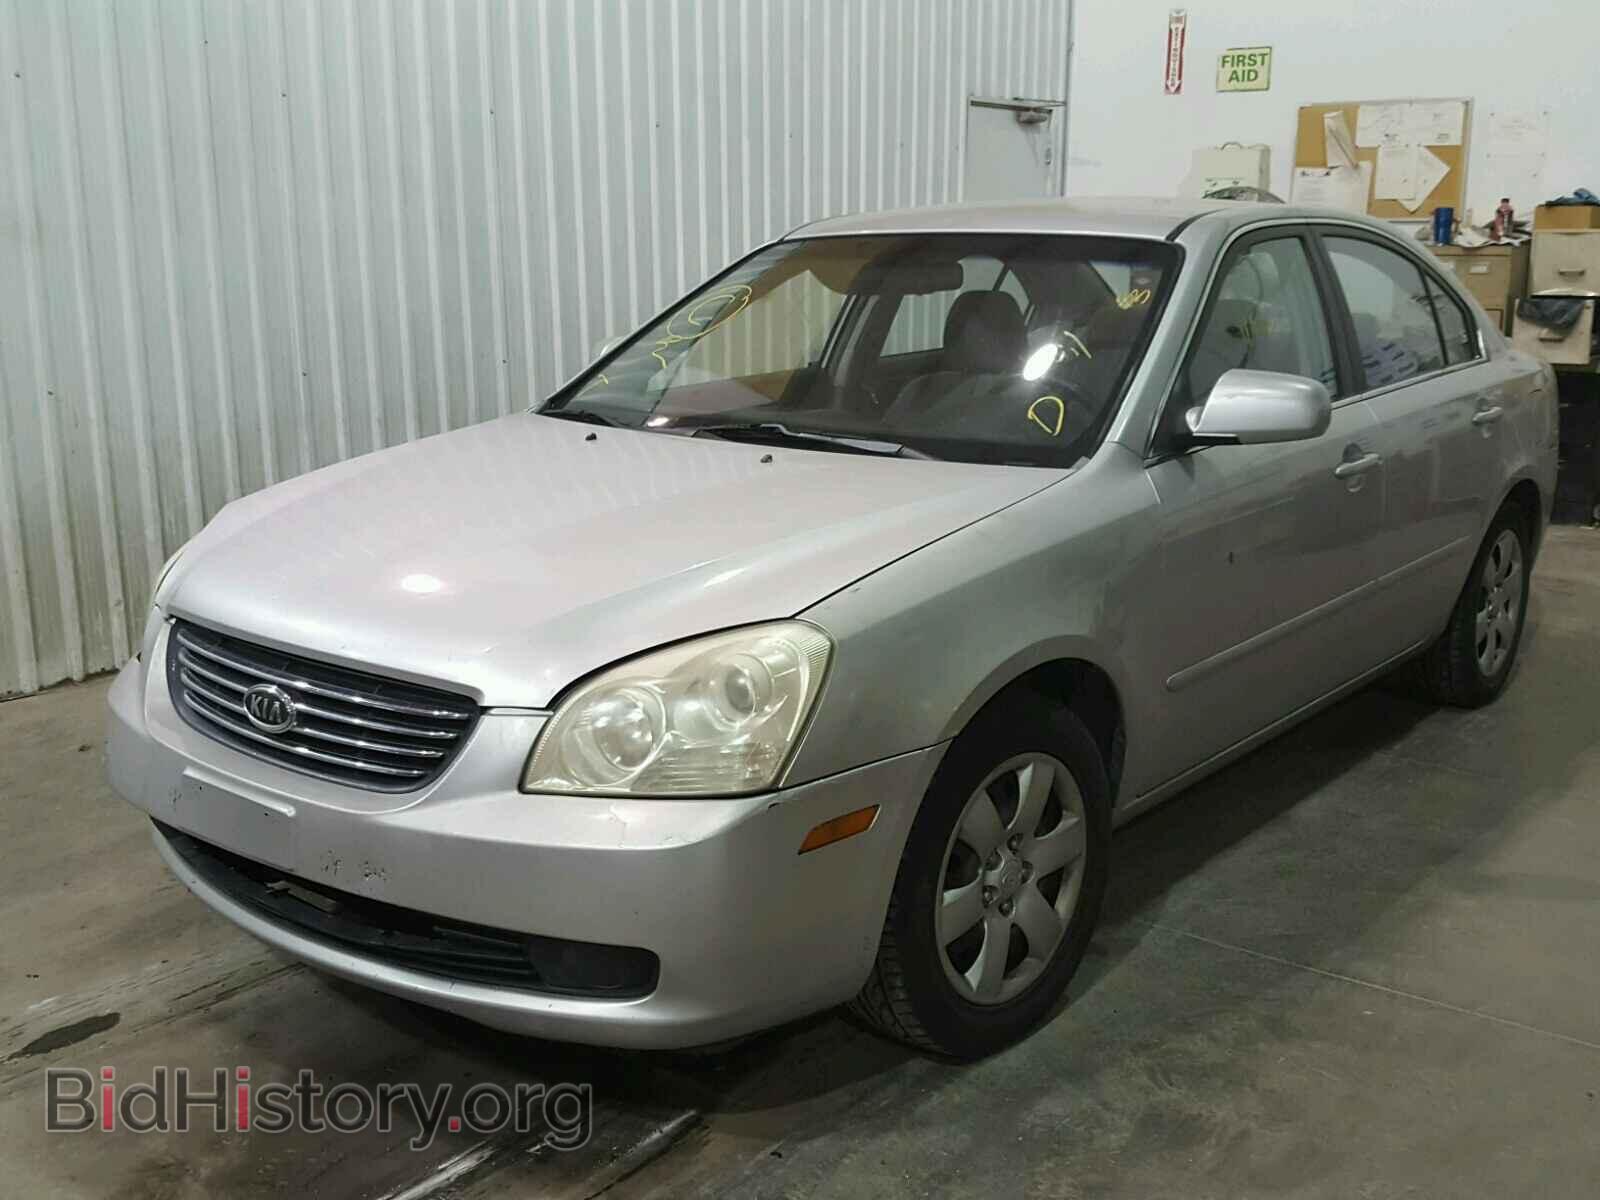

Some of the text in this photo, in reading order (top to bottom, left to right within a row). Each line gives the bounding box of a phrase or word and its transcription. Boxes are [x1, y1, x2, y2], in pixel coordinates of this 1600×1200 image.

[1221, 53, 1268, 69] FIRST
[1228, 69, 1259, 83] AID
[250, 693, 282, 723] KIA
